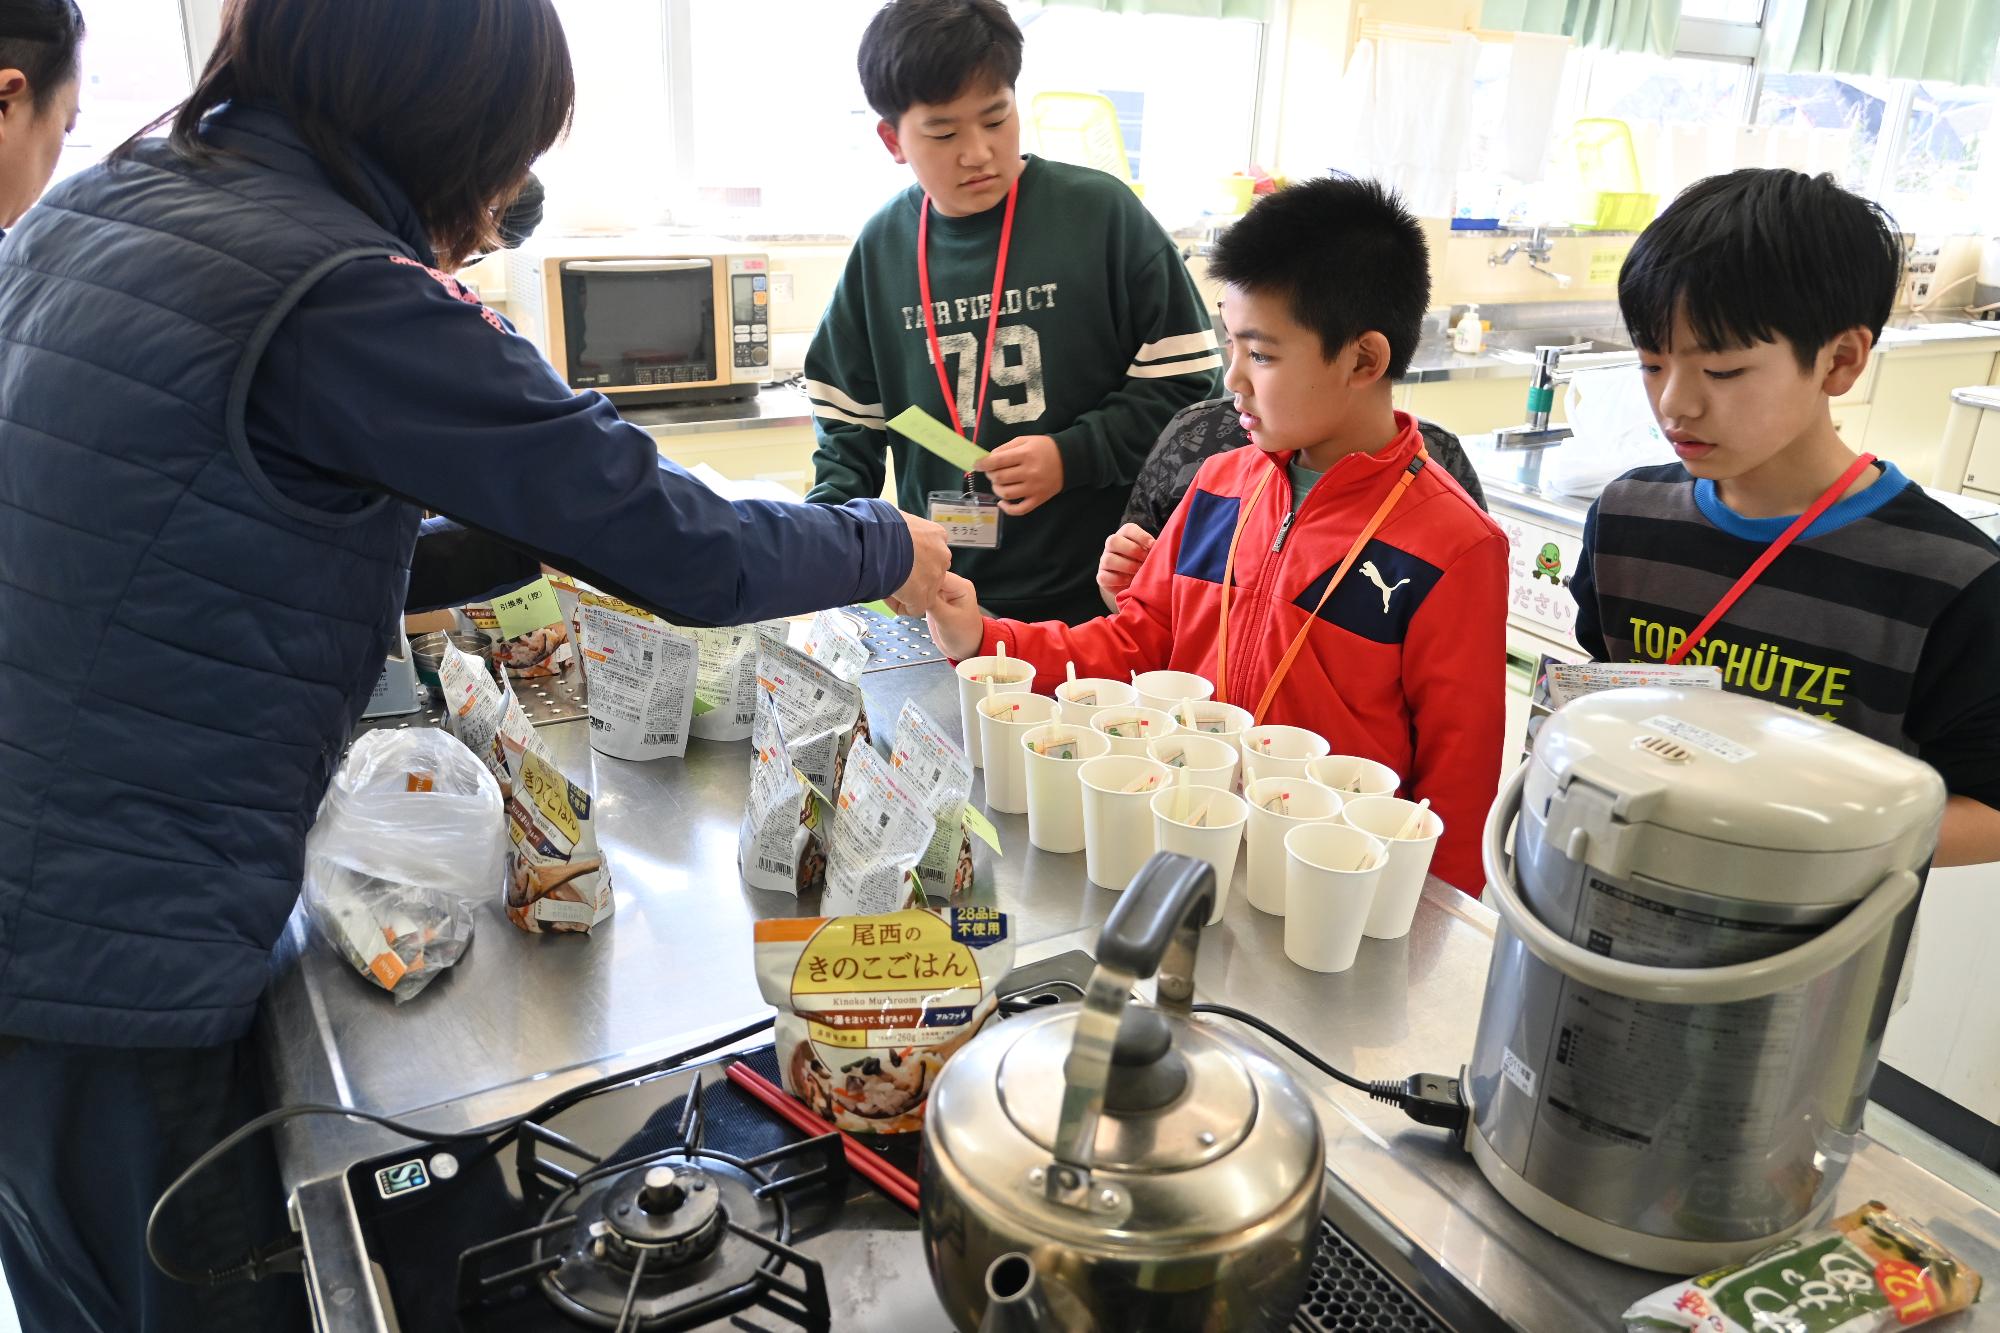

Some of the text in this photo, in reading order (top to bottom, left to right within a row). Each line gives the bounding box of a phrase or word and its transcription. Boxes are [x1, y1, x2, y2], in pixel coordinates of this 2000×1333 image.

[1026, 283, 1058, 310] CT
[926, 324, 1046, 428] 79
[1629, 617, 1850, 706] TORSCHÜTZE
[957, 907, 999, 920] 28品目
[852, 923, 921, 946] 尾西の
[958, 922, 1000, 937] 不使用
[808, 951, 968, 983] きのこごはん
[833, 995, 941, 1006] Kinoko Mushroom Rce
